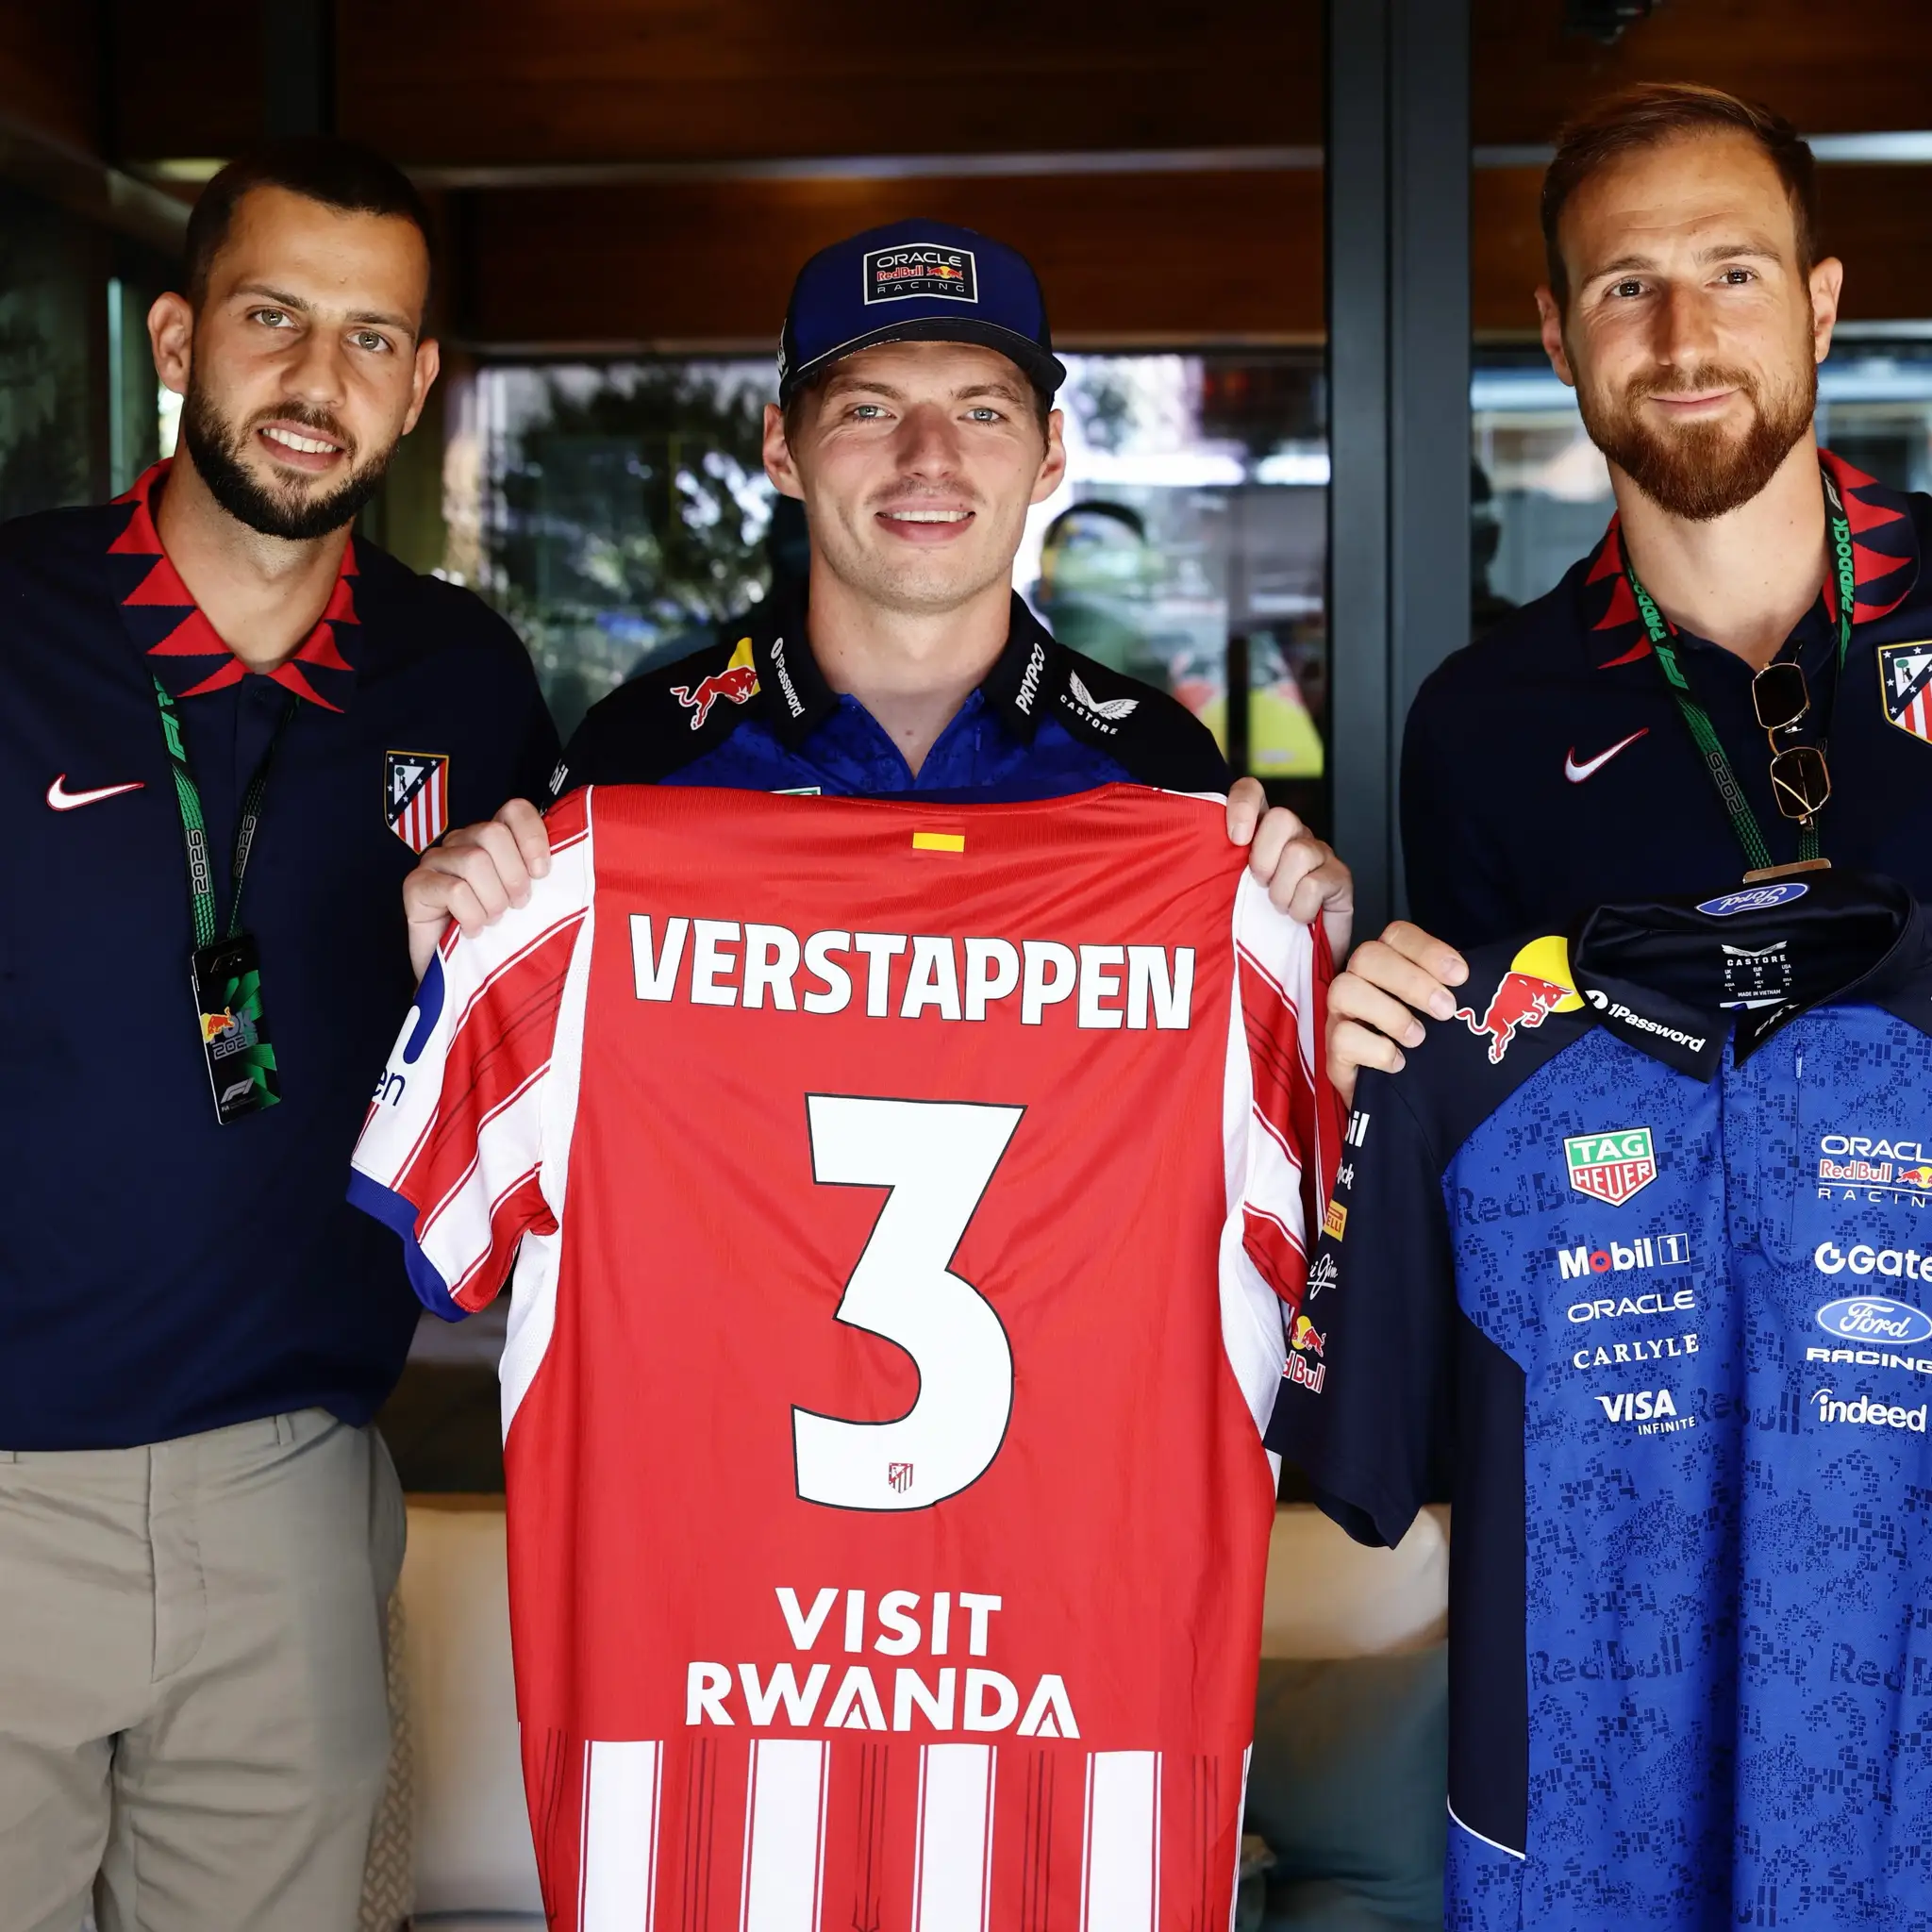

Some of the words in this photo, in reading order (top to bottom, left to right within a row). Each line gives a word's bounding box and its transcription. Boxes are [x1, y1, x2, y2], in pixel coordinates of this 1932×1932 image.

[876, 252, 962, 269] ORACLE
[877, 281, 965, 294] RACING
[1832, 516, 1855, 613] PADDOCK
[775, 653, 806, 719] 1Password
[1015, 642, 1045, 715] PRYPCO
[1655, 645, 1690, 691] F1
[1059, 694, 1118, 735] CASTORE
[160, 710, 187, 763] F1
[1707, 751, 1743, 813] 2026
[187, 829, 209, 894] 2026
[628, 913, 1196, 1031] VERSTAPPEN
[1726, 955, 1787, 967] CASTORE
[1608, 1003, 1707, 1053] 1Password
[1573, 1134, 1645, 1164] TAG
[1821, 1135, 1932, 1164] ORACL
[1573, 1161, 1653, 1201] HEUER
[1818, 1187, 1926, 1208] RACIN
[1557, 1237, 1655, 1280] Mobil
[791, 1091, 1029, 1513] 3
[1567, 1289, 1696, 1324] ORACLE
[1839, 1302, 1912, 1339] Ford
[1573, 1333, 1700, 1370] CARLYLE
[1594, 1389, 1677, 1423] VISA
[1638, 1416, 1696, 1436] INFINITE
[1811, 1389, 1928, 1433] indeed
[774, 1587, 1003, 1657] VISIT
[685, 1660, 1081, 1740] RWANDA
